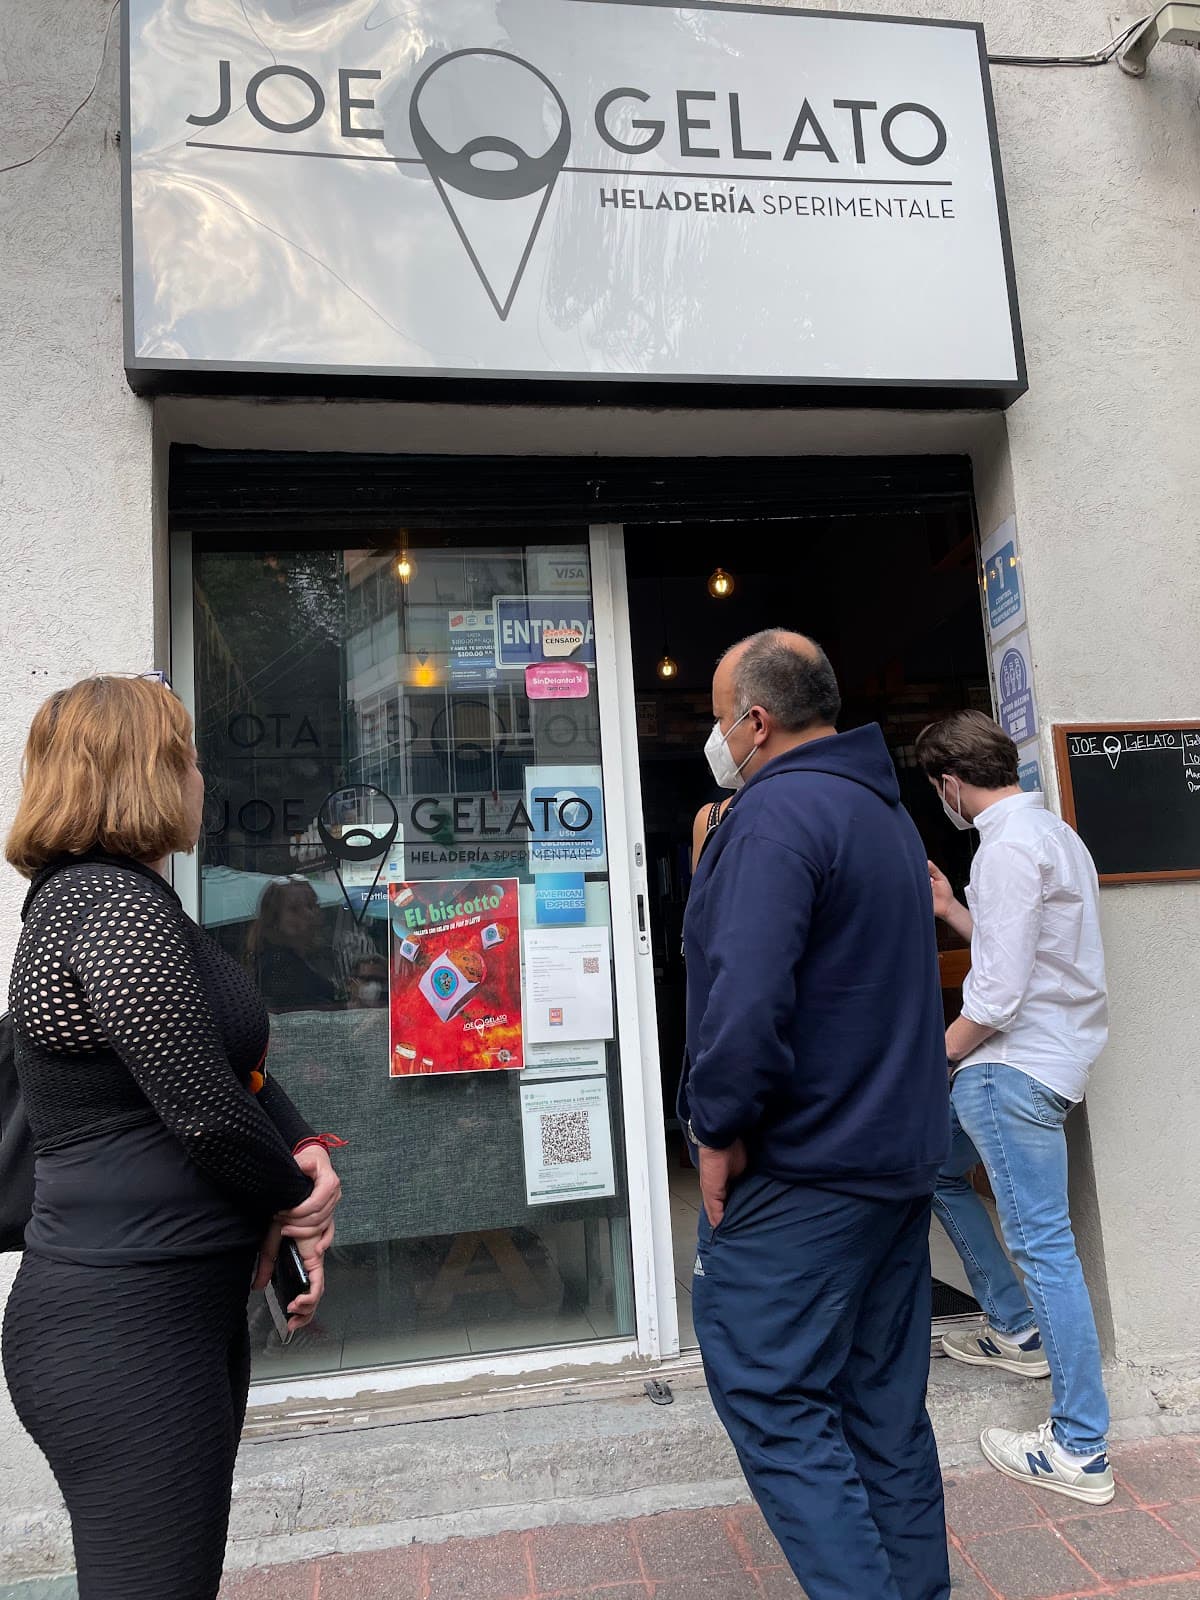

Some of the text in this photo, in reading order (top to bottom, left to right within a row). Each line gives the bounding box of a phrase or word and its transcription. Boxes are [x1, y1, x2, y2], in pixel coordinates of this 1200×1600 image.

[187, 60, 948, 167] JOE GELATO
[600, 185, 956, 220] HELADERÍA SPERIMENTALE
[555, 567, 585, 579] VISA
[545, 637, 581, 645] CENSADO
[1069, 733, 1175, 754] JOE GELATO
[410, 797, 593, 836] GELATO
[411, 846, 489, 865] HELADERÍA
[536, 889, 583, 899] AMERICAN
[545, 899, 585, 909] EXPRESS
[404, 894, 500, 929] EL biscotto
